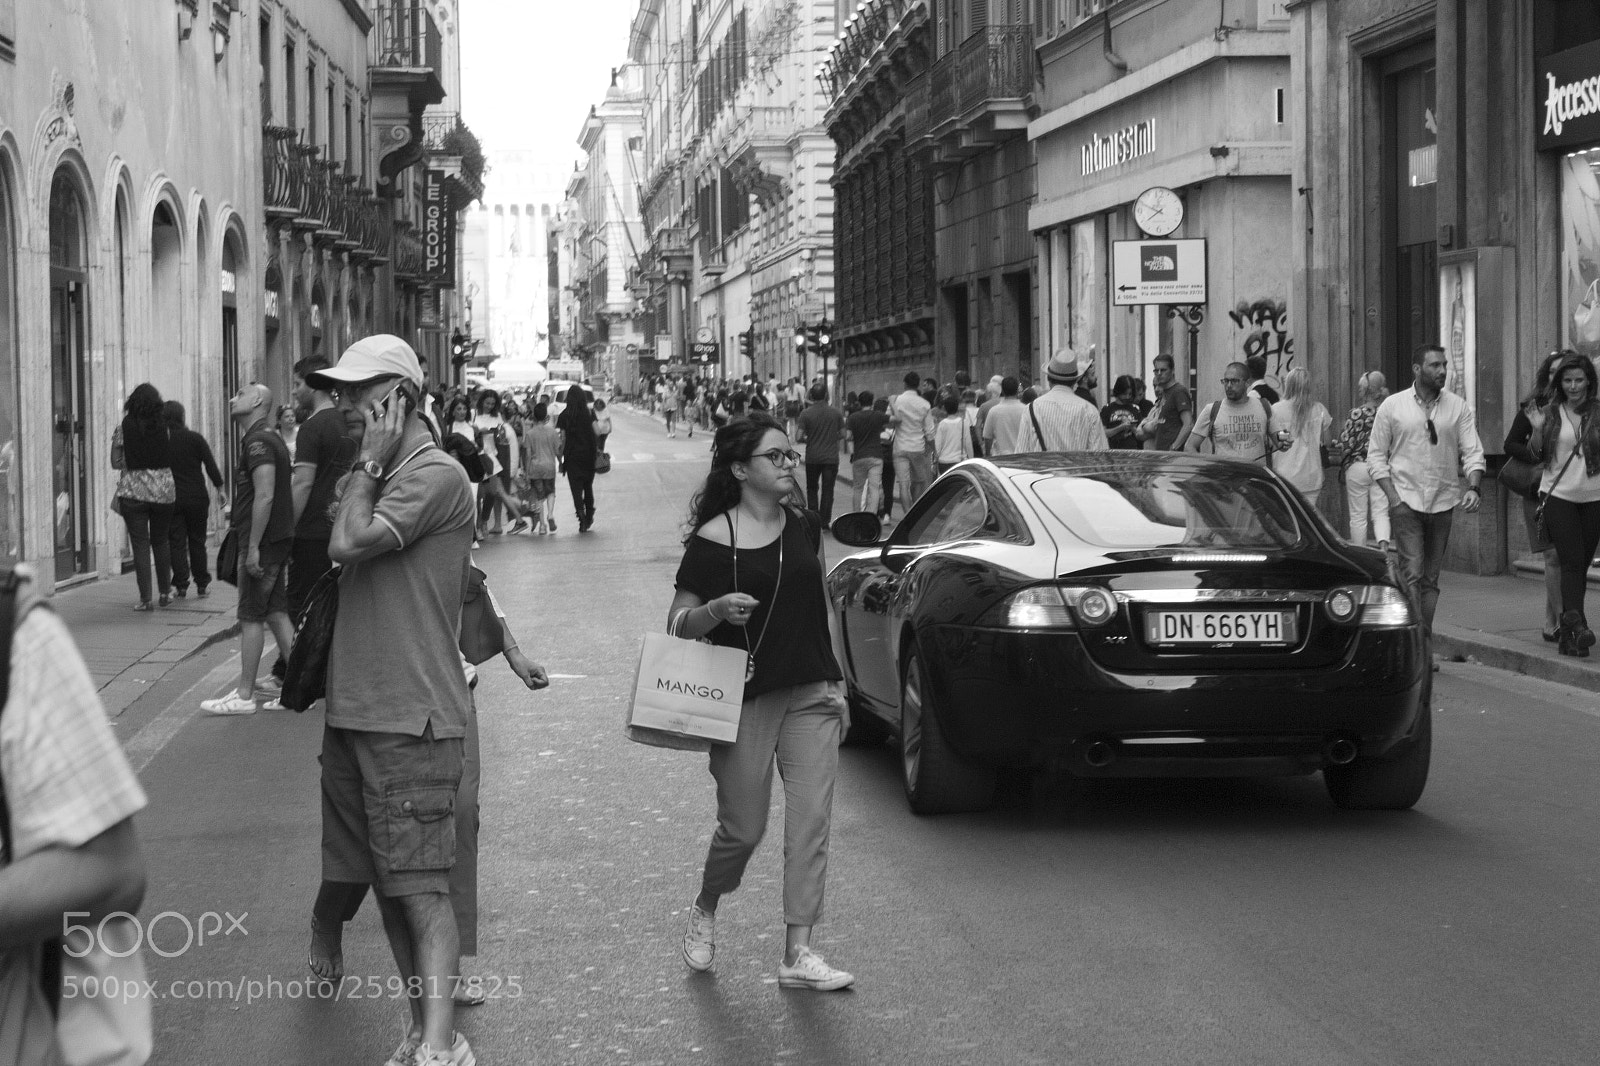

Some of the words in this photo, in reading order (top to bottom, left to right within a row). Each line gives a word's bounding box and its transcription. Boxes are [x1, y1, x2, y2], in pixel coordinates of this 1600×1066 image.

[1543, 72, 1600, 136] Access
[1080, 117, 1156, 176] intimissimi
[427, 174, 440, 201] LE
[426, 205, 440, 272] GROUP
[1229, 414, 1255, 424] TOMMY
[1164, 614, 1193, 639] DN
[1204, 613, 1279, 638] 666YH
[656, 677, 724, 700] MANGO
